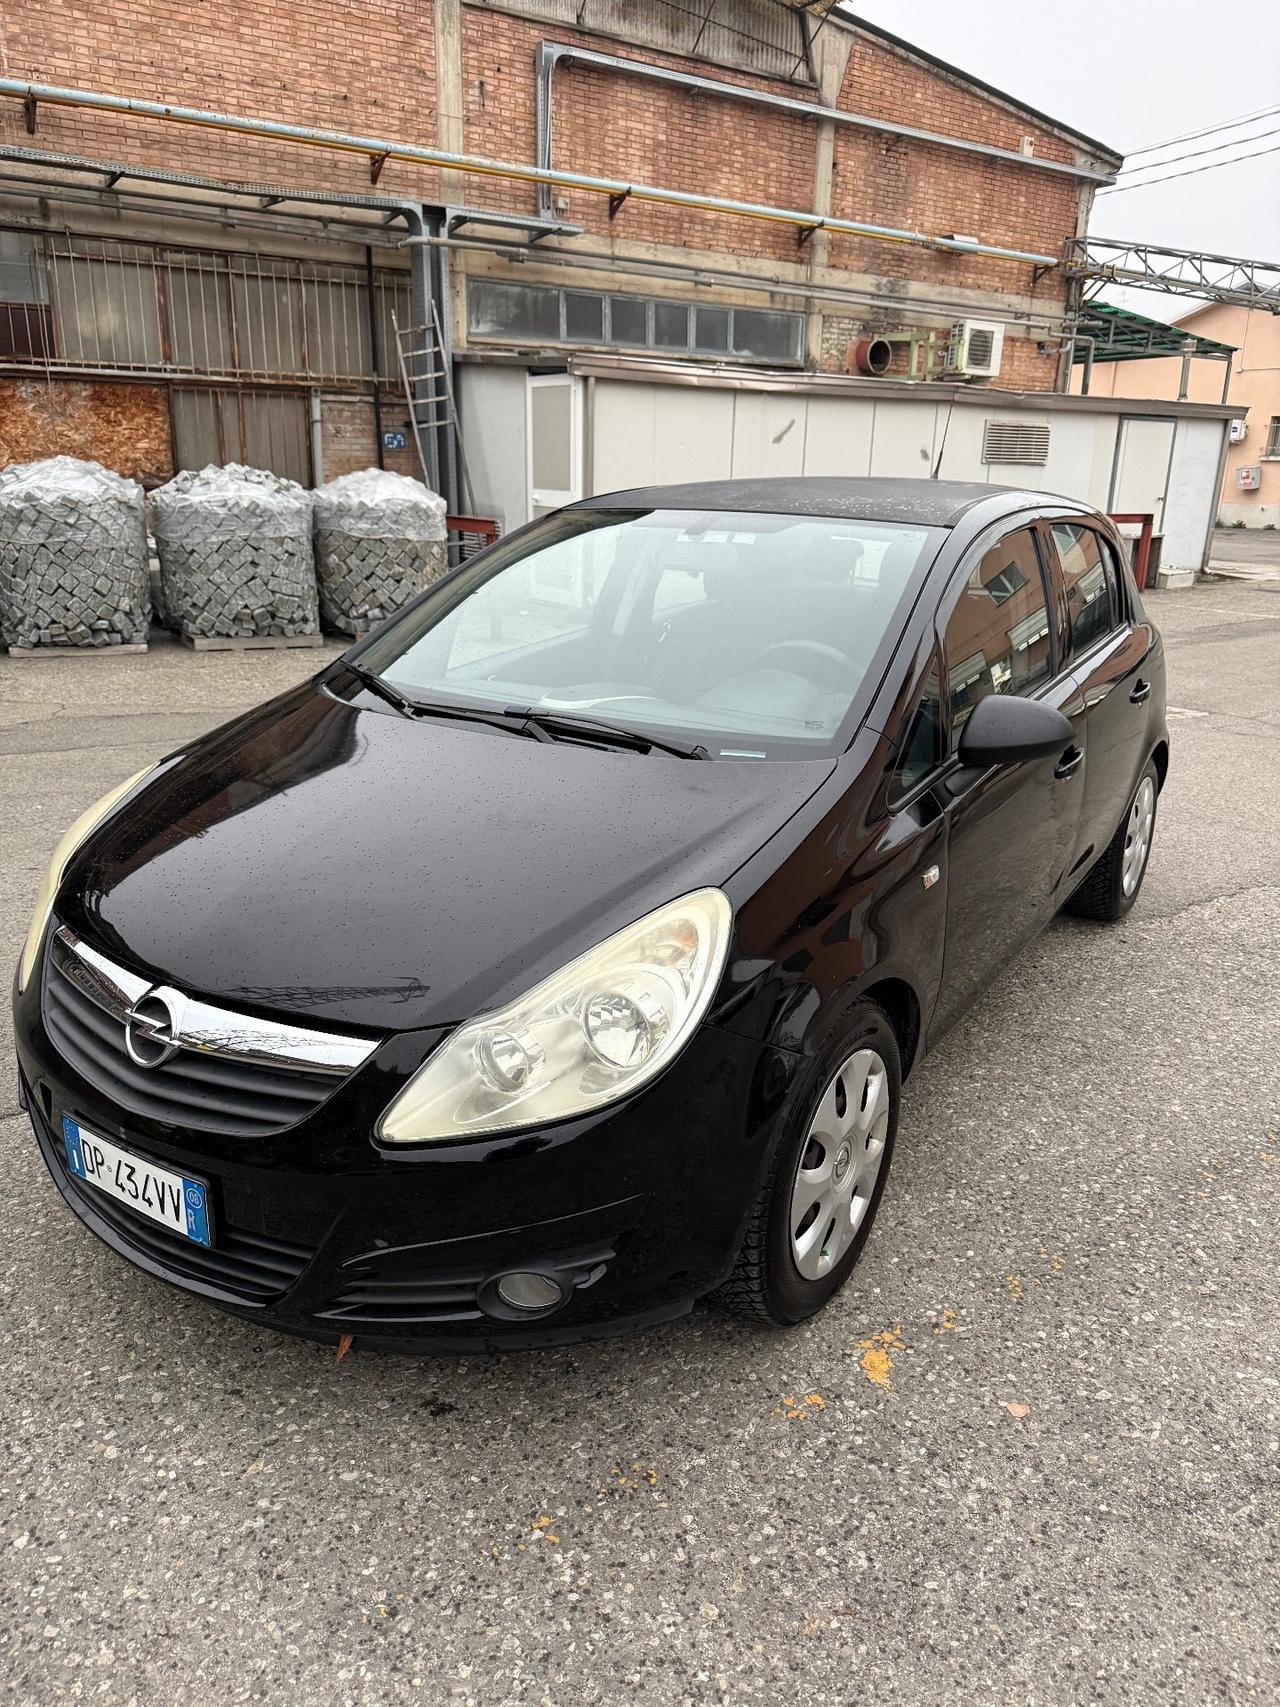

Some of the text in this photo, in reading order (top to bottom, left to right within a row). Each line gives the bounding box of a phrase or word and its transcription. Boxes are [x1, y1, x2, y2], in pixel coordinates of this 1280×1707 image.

[73, 1149, 79, 1170] I
[189, 1191, 199, 1205] 08
[187, 1208, 196, 1231] R
